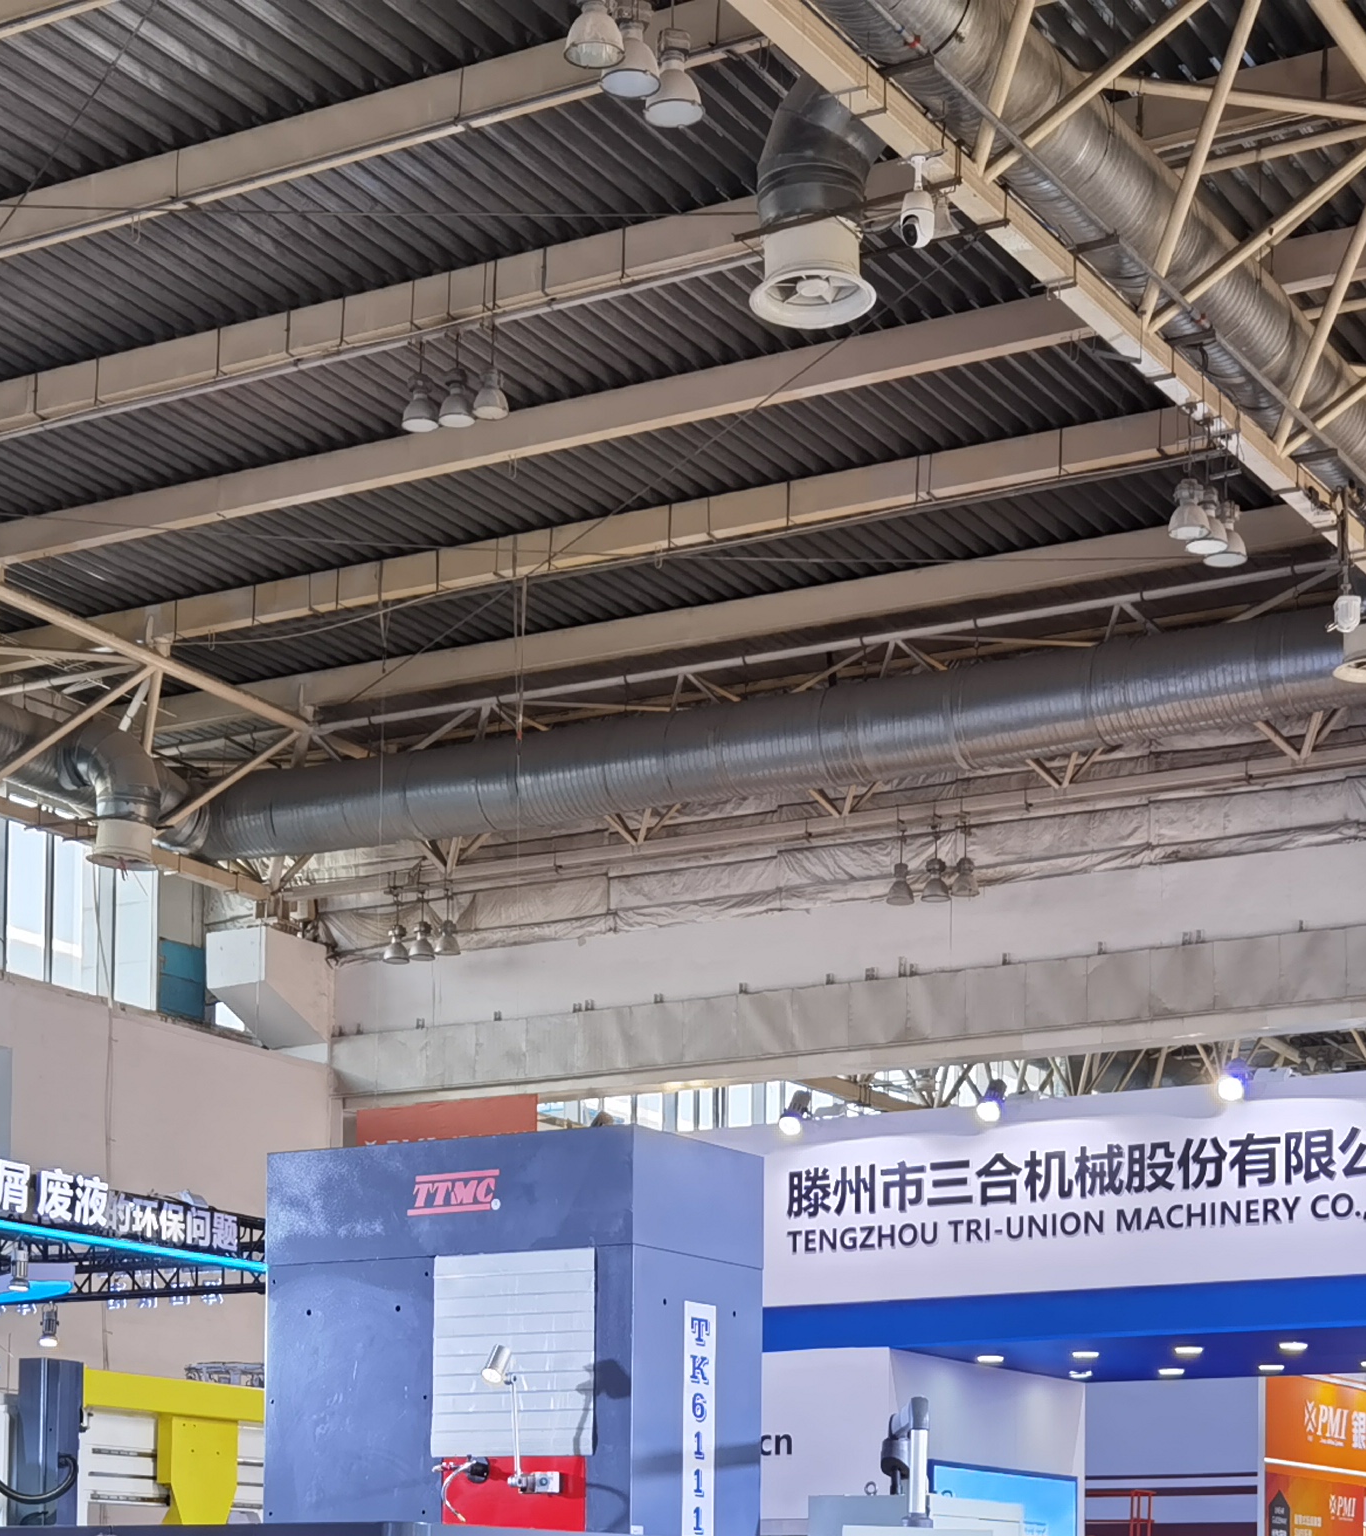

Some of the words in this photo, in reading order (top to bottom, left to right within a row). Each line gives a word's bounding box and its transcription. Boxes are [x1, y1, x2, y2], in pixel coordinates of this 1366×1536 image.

[410, 1173, 498, 1210] TTMC
[786, 1222, 940, 1254] TENGZHOU
[948, 1211, 1106, 1245] TRI-UNION
[1115, 1197, 1297, 1234] MACHINERY
[689, 1316, 710, 1536] TK6111
[1316, 1404, 1350, 1441] PMI
